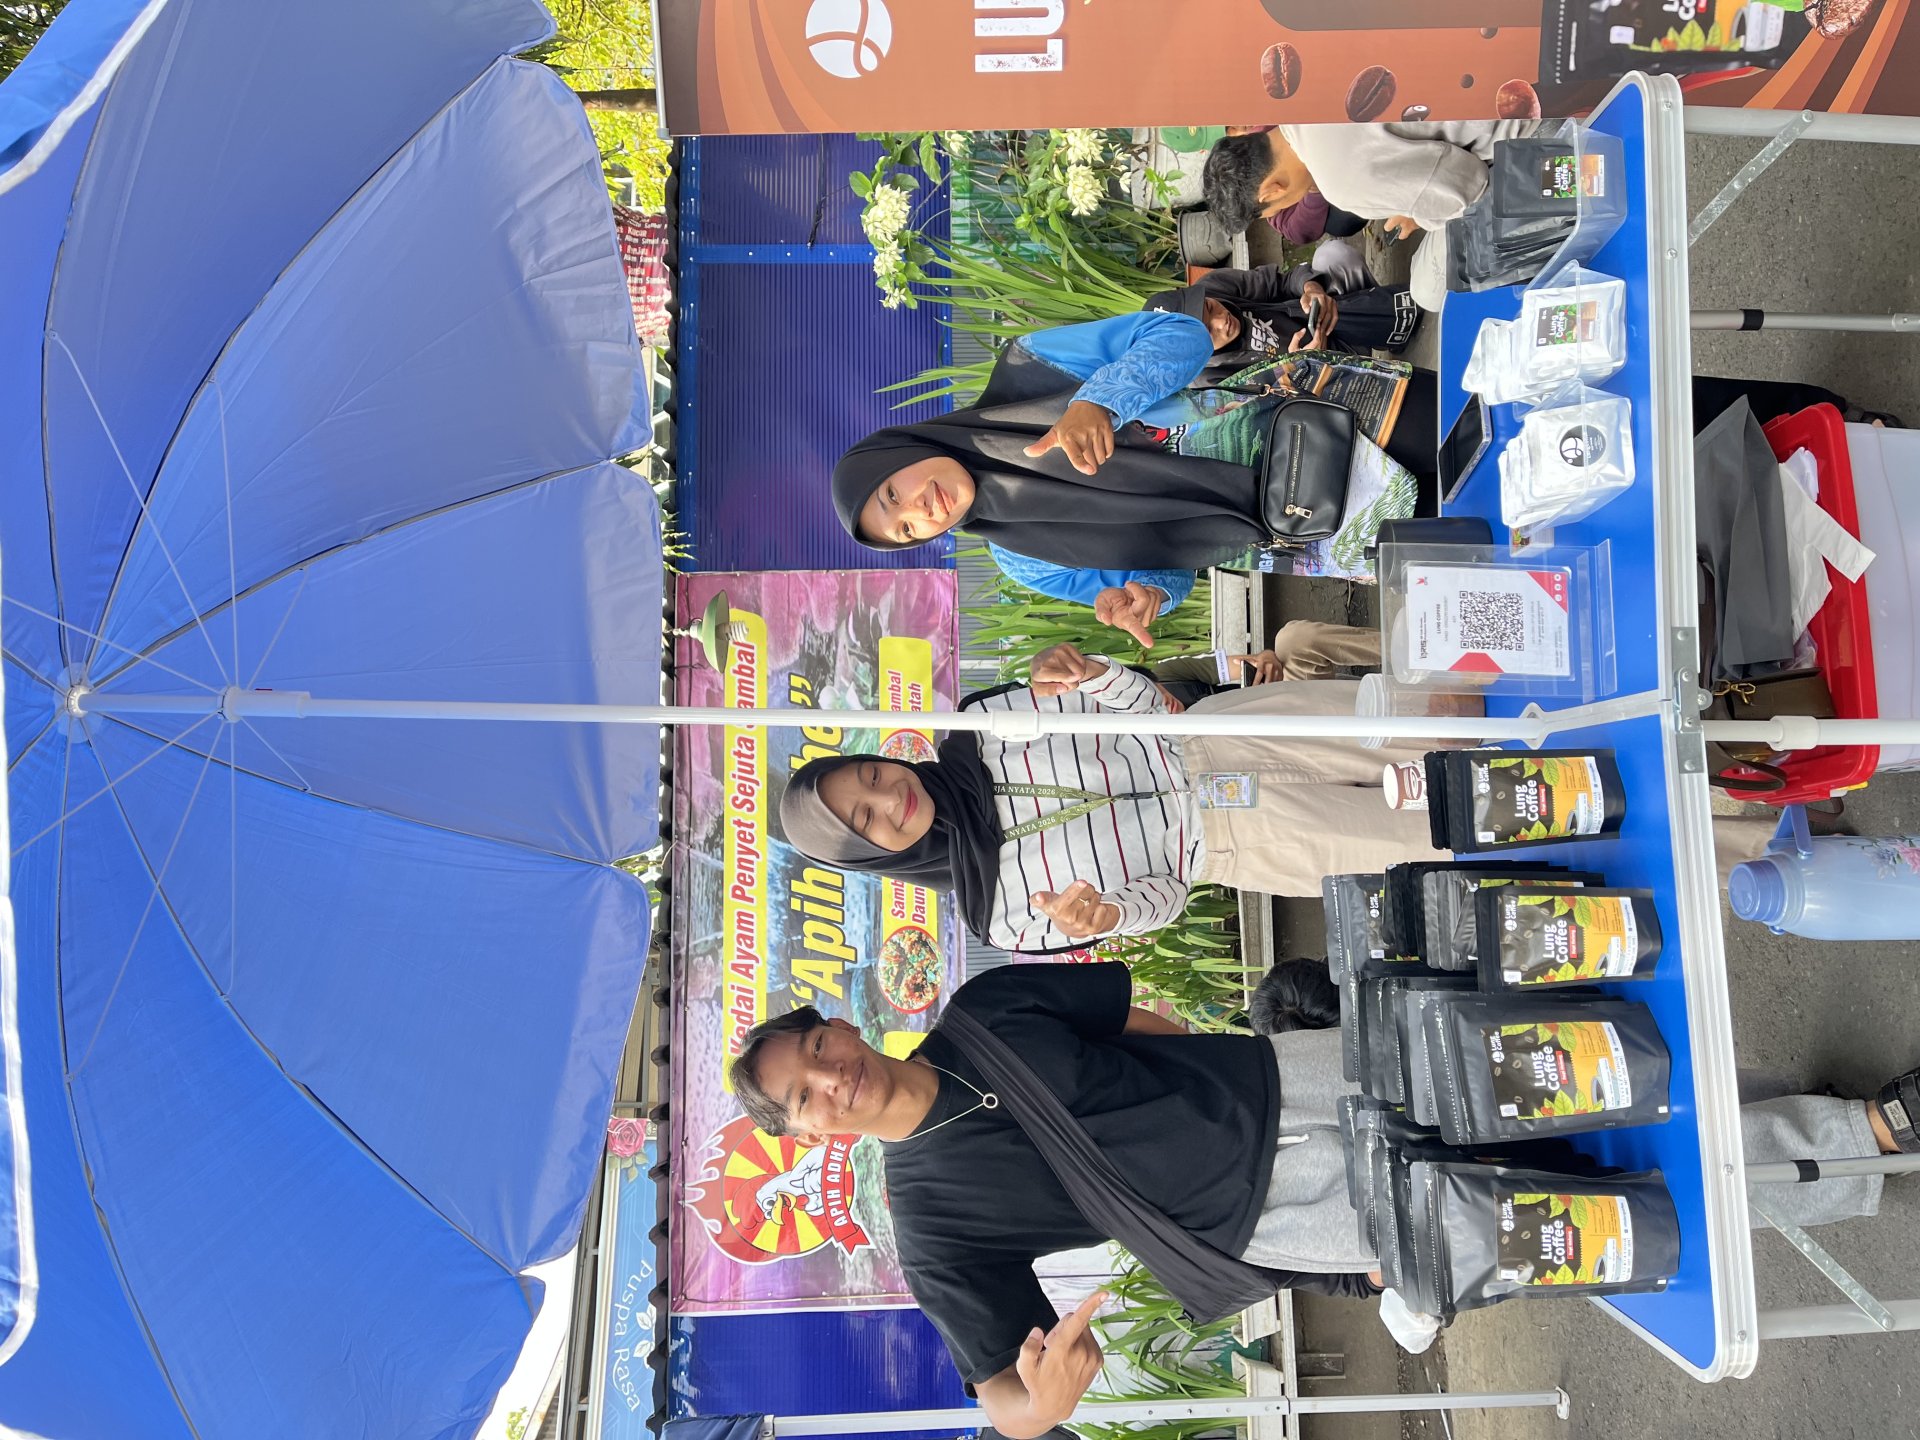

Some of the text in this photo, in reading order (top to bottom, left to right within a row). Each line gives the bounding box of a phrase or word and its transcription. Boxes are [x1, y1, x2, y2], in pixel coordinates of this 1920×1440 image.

[1554, 166, 1562, 188] Lung
[1560, 164, 1568, 190] Coffee
[1549, 315, 1560, 336] Lung
[1556, 312, 1565, 338] Coffee
[732, 640, 755, 728] ambal
[888, 670, 901, 712] ambal
[908, 683, 921, 712] atah
[731, 739, 759, 812] Sejuta
[1008, 786, 1035, 794] NYATA
[1515, 784, 1528, 817] Lung
[1526, 780, 1538, 822] Coffee
[1009, 816, 1056, 837] NYATA 2026
[731, 820, 759, 903] Penyet
[890, 880, 905, 918] Samb
[912, 886, 926, 924] Daun
[731, 910, 759, 980] Ayam
[1543, 924, 1557, 958] Lung
[1556, 920, 1568, 963] Coffee
[1531, 1052, 1546, 1086] Lung
[1544, 1046, 1560, 1090] Coffee
[826, 1141, 848, 1226] APIH ADHE
[1540, 1224, 1554, 1260] Lung
[1552, 1220, 1565, 1264] Coffee
[613, 1260, 653, 1412] Puspa Rasa
